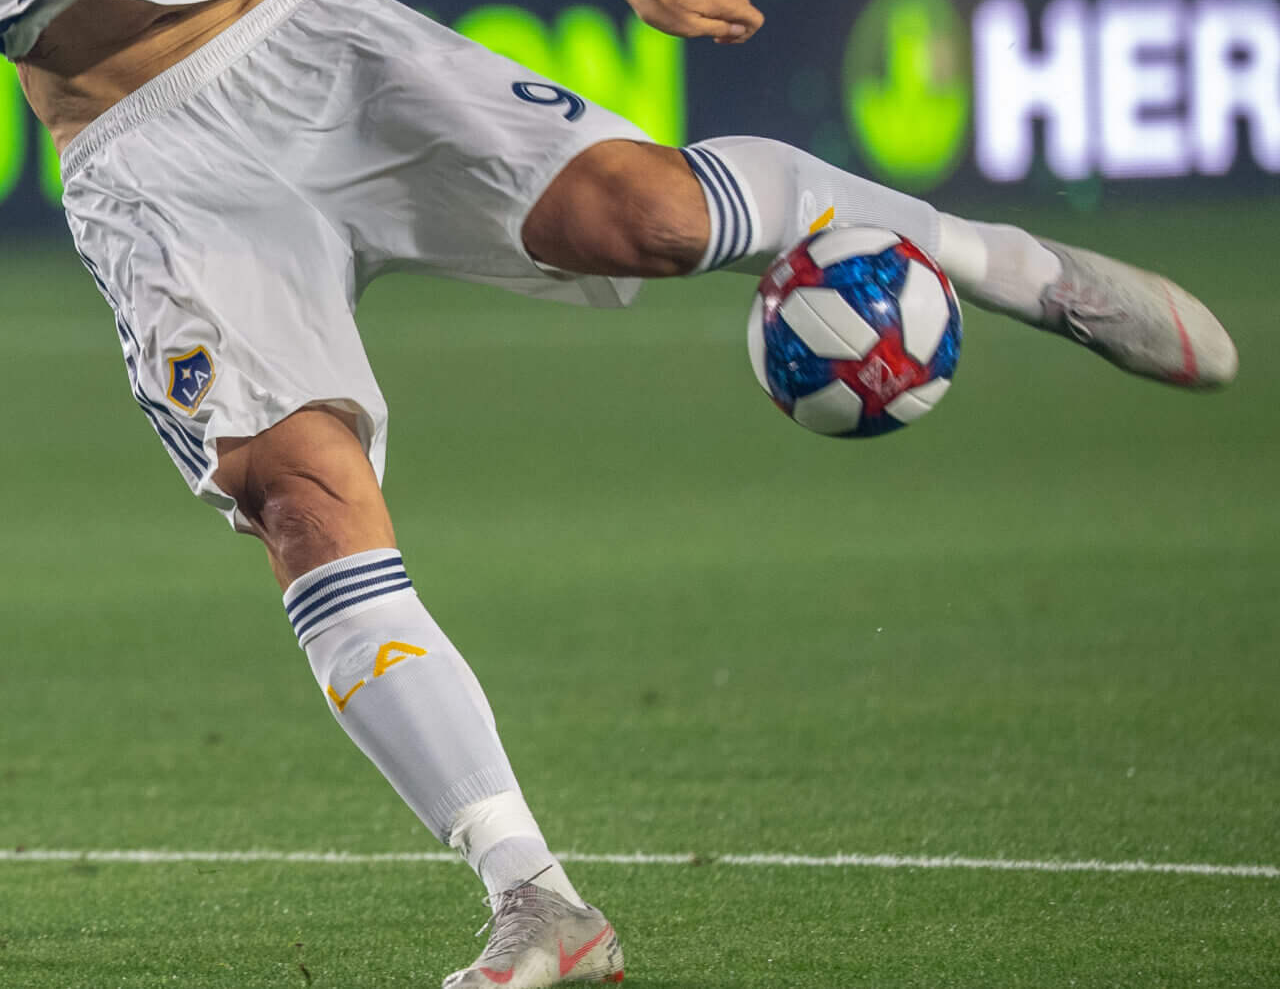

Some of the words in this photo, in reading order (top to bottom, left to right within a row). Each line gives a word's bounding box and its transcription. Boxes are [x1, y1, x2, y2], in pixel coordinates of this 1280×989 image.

[512, 81, 586, 123] 9
[182, 370, 209, 401] LA
[327, 641, 428, 714] LA
